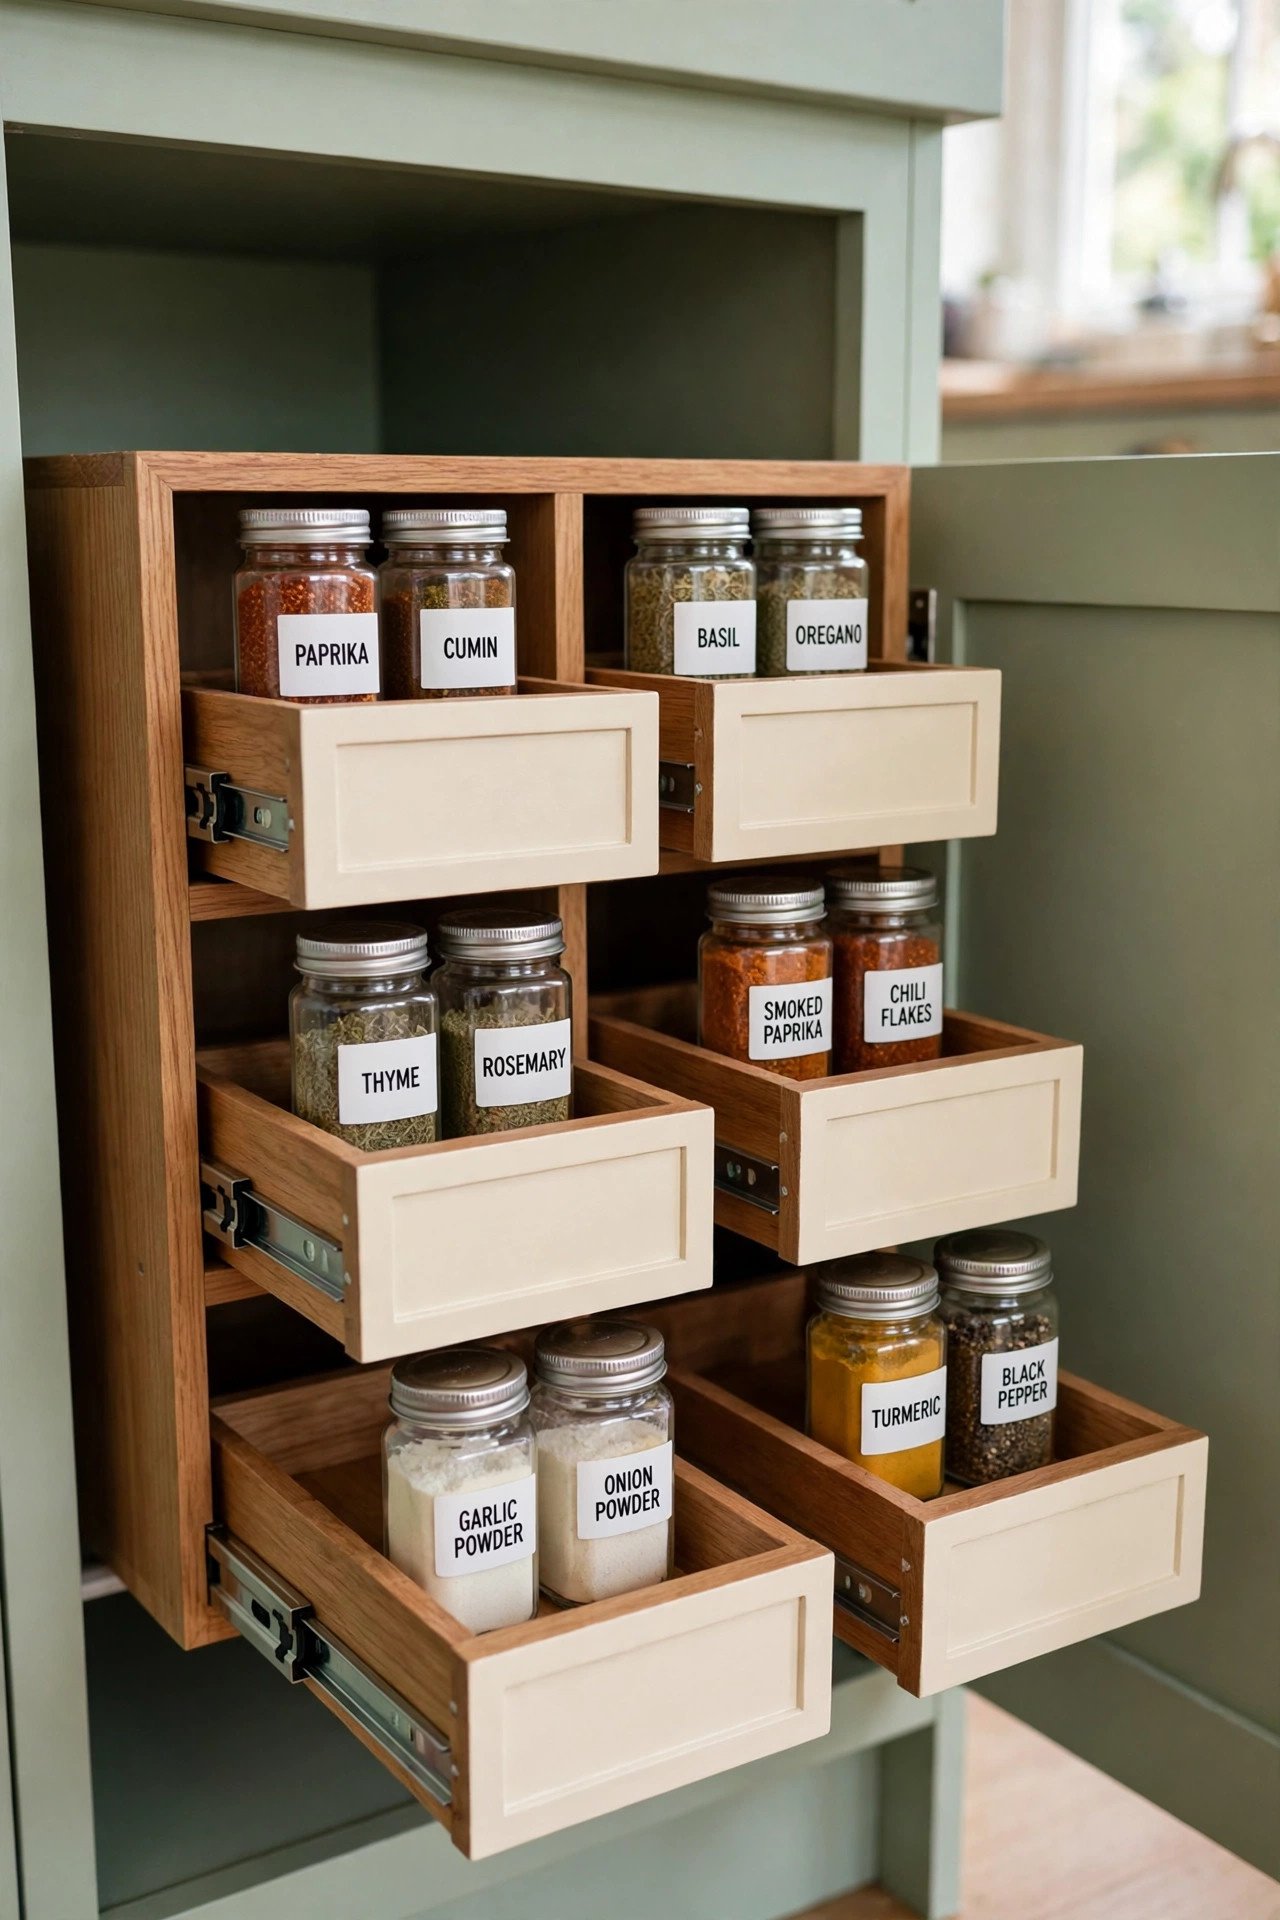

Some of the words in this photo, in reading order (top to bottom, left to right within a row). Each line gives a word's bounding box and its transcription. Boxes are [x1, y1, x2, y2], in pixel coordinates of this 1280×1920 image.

[444, 636, 497, 659] CUMIN
[698, 627, 740, 648] BASIL
[796, 624, 861, 645] OREGANO
[295, 642, 369, 666] PAPRIKA
[890, 982, 925, 1004] CHILI
[764, 996, 823, 1021] SMOKED
[882, 1003, 932, 1027] FLAKES
[764, 1019, 823, 1044] PAPRIKA
[483, 1047, 566, 1077] ROSEMARY
[361, 1066, 420, 1094] THYME
[1003, 1359, 1045, 1386] BLACK
[998, 1380, 1047, 1409] PEPPER
[872, 1395, 941, 1428] TURMERIC
[605, 1465, 652, 1495] ONION
[459, 1499, 517, 1532] GARLIC
[596, 1488, 660, 1522] POWDER
[455, 1523, 523, 1558] POWDER
